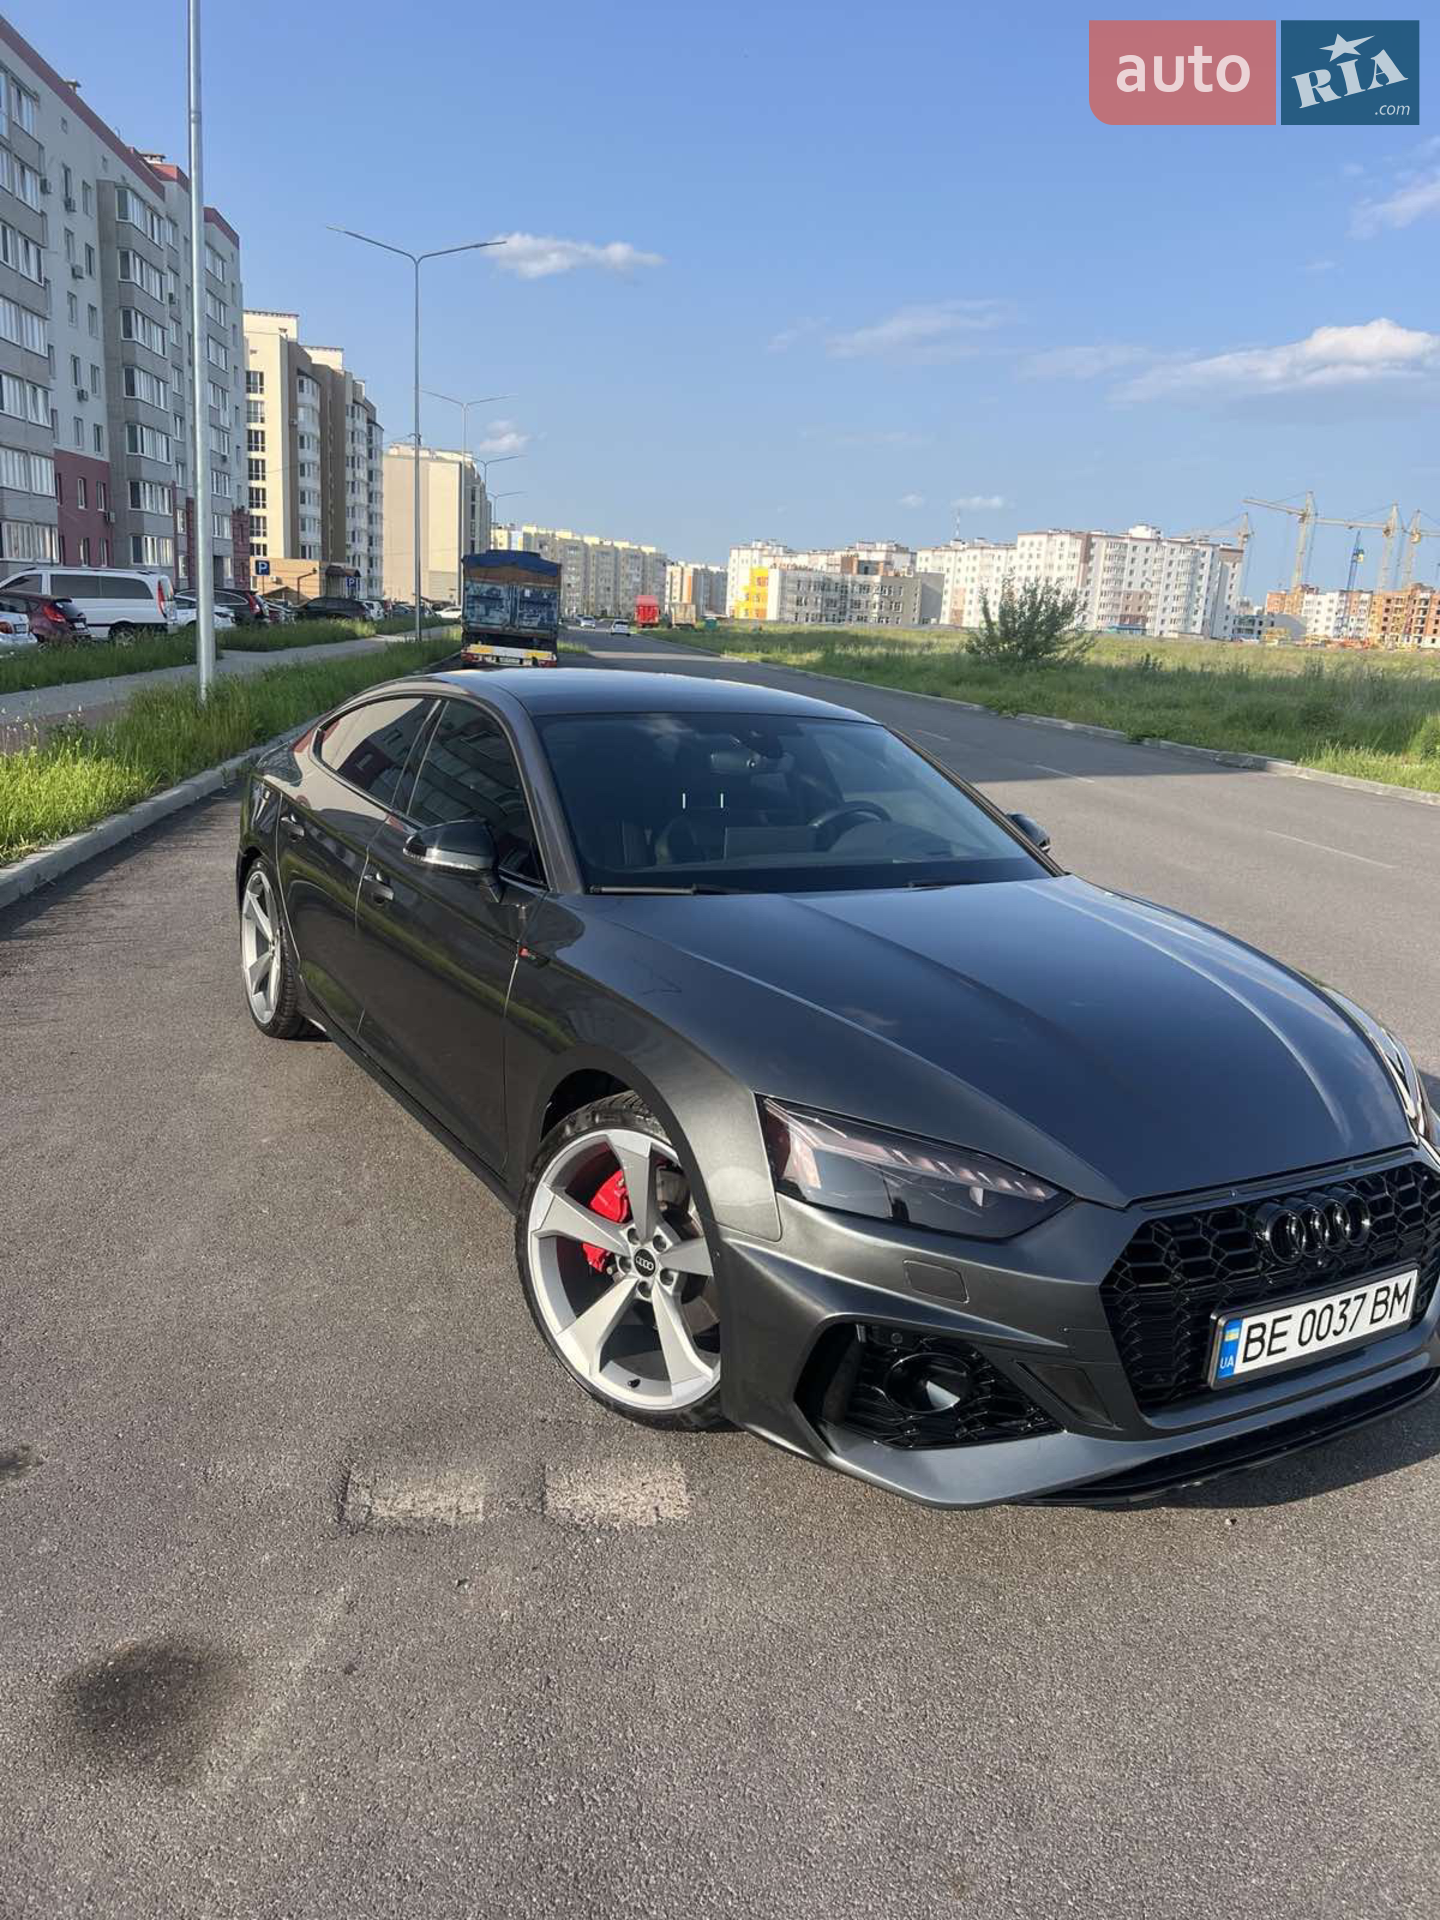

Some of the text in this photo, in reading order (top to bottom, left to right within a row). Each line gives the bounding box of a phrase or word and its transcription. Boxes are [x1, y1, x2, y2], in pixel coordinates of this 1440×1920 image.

[1243, 1278, 1412, 1363] BE 0037 BM
[1220, 1355, 1234, 1369] UA
